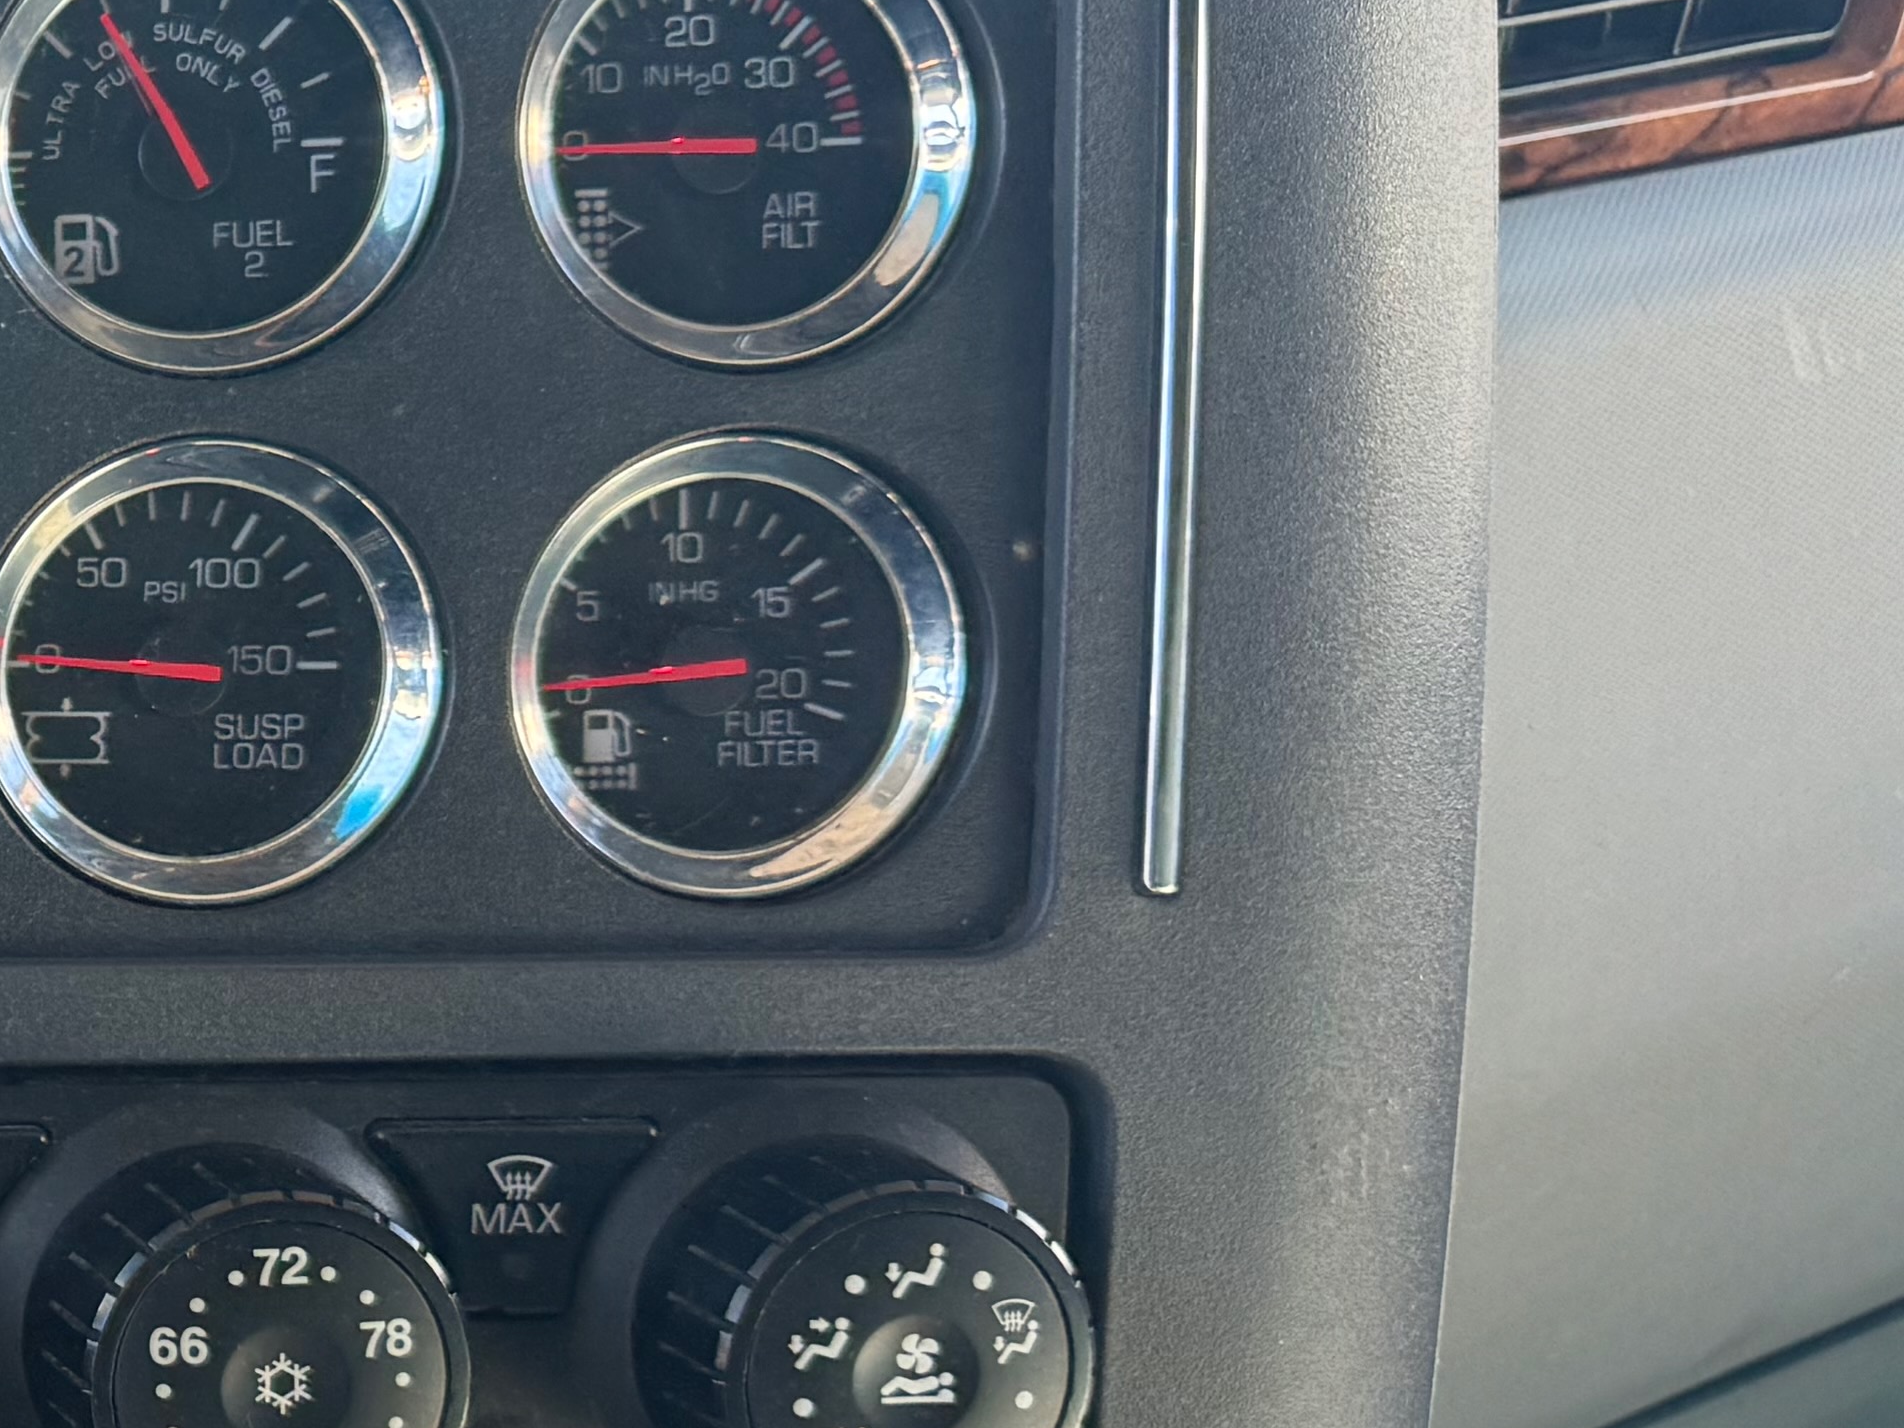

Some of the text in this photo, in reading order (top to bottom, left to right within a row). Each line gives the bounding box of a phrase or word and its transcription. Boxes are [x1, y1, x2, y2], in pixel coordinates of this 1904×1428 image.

[153, 22, 246, 65] SULFUR
[664, 15, 716, 48] 20
[175, 53, 241, 94] ONLY
[579, 63, 623, 94] 10
[743, 56, 795, 89] 30
[42, 80, 81, 161] ULTRA
[250, 67, 292, 153] DIESEL
[563, 130, 589, 162] 0
[766, 122, 819, 154] 40
[310, 154, 336, 193] F
[762, 191, 817, 219] AIR
[212, 219, 293, 247] FUEL
[762, 222, 820, 250] FILT
[244, 251, 268, 278] 2
[660, 532, 704, 564] 10
[77, 557, 127, 589] 50
[189, 557, 261, 589] 100
[144, 581, 187, 604] PSI
[576, 591, 601, 622] 5
[751, 587, 792, 620] 15
[35, 644, 62, 674] 0
[227, 644, 293, 675] 150
[565, 674, 592, 705] 0
[755, 668, 808, 700] 20
[213, 714, 304, 740] SUSP
[724, 710, 807, 737] FUEL
[213, 742, 304, 770] LOAD
[717, 739, 819, 767] FILTER
[470, 1200, 563, 1236] MAX
[252, 1245, 310, 1286] 72
[149, 1326, 210, 1366] 66
[359, 1317, 413, 1358] 78
